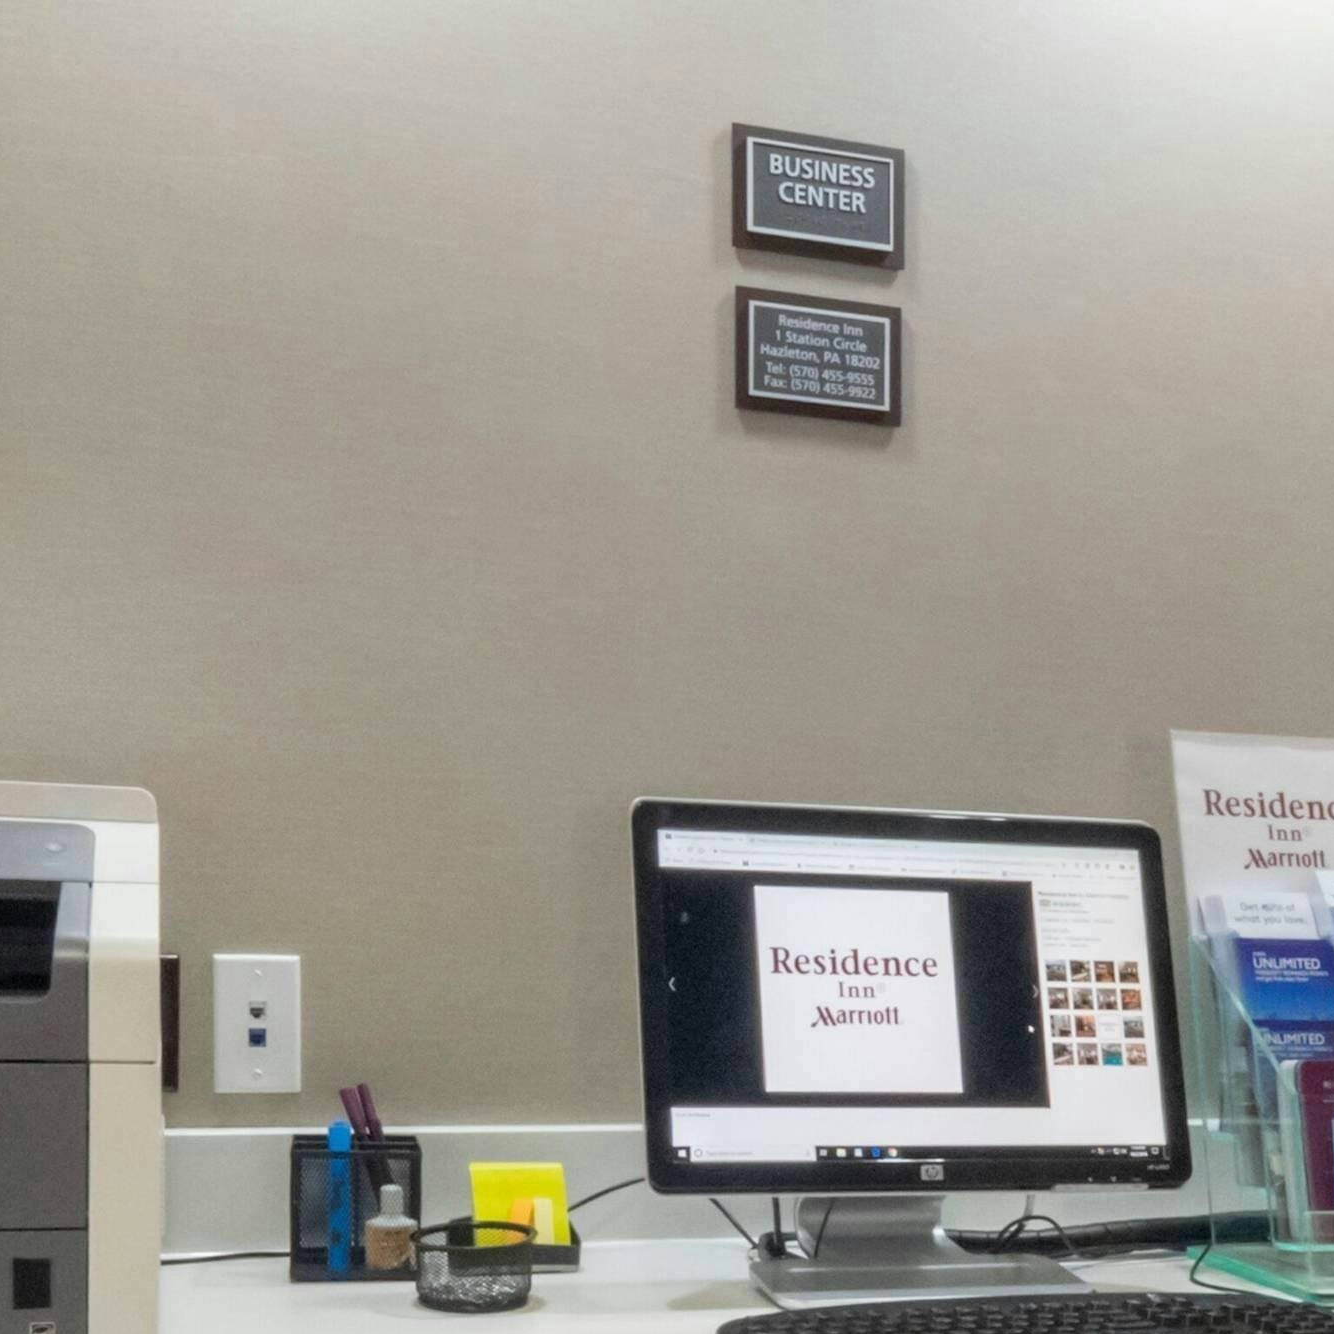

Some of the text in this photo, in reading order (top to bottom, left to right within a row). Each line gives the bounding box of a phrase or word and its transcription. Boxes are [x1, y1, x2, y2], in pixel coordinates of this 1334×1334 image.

[769, 153, 875, 189] BUSINESS
[778, 181, 867, 213] CENTER
[778, 314, 864, 337] Residence Inn
[775, 330, 867, 353] 1 Station Circle
[759, 344, 881, 370] Hazleton, PA 18202
[765, 361, 787, 375] Tel:
[789, 364, 819, 380] (570)
[763, 375, 787, 389] Fax:
[790, 378, 820, 394] (570)
[1244, 848, 1327, 870] Marriott
[769, 946, 939, 977] Residence
[1252, 957, 1321, 970] UNLIMITED
[811, 1005, 900, 1028] Marriott
[1263, 1032, 1326, 1046] NLIMITED
